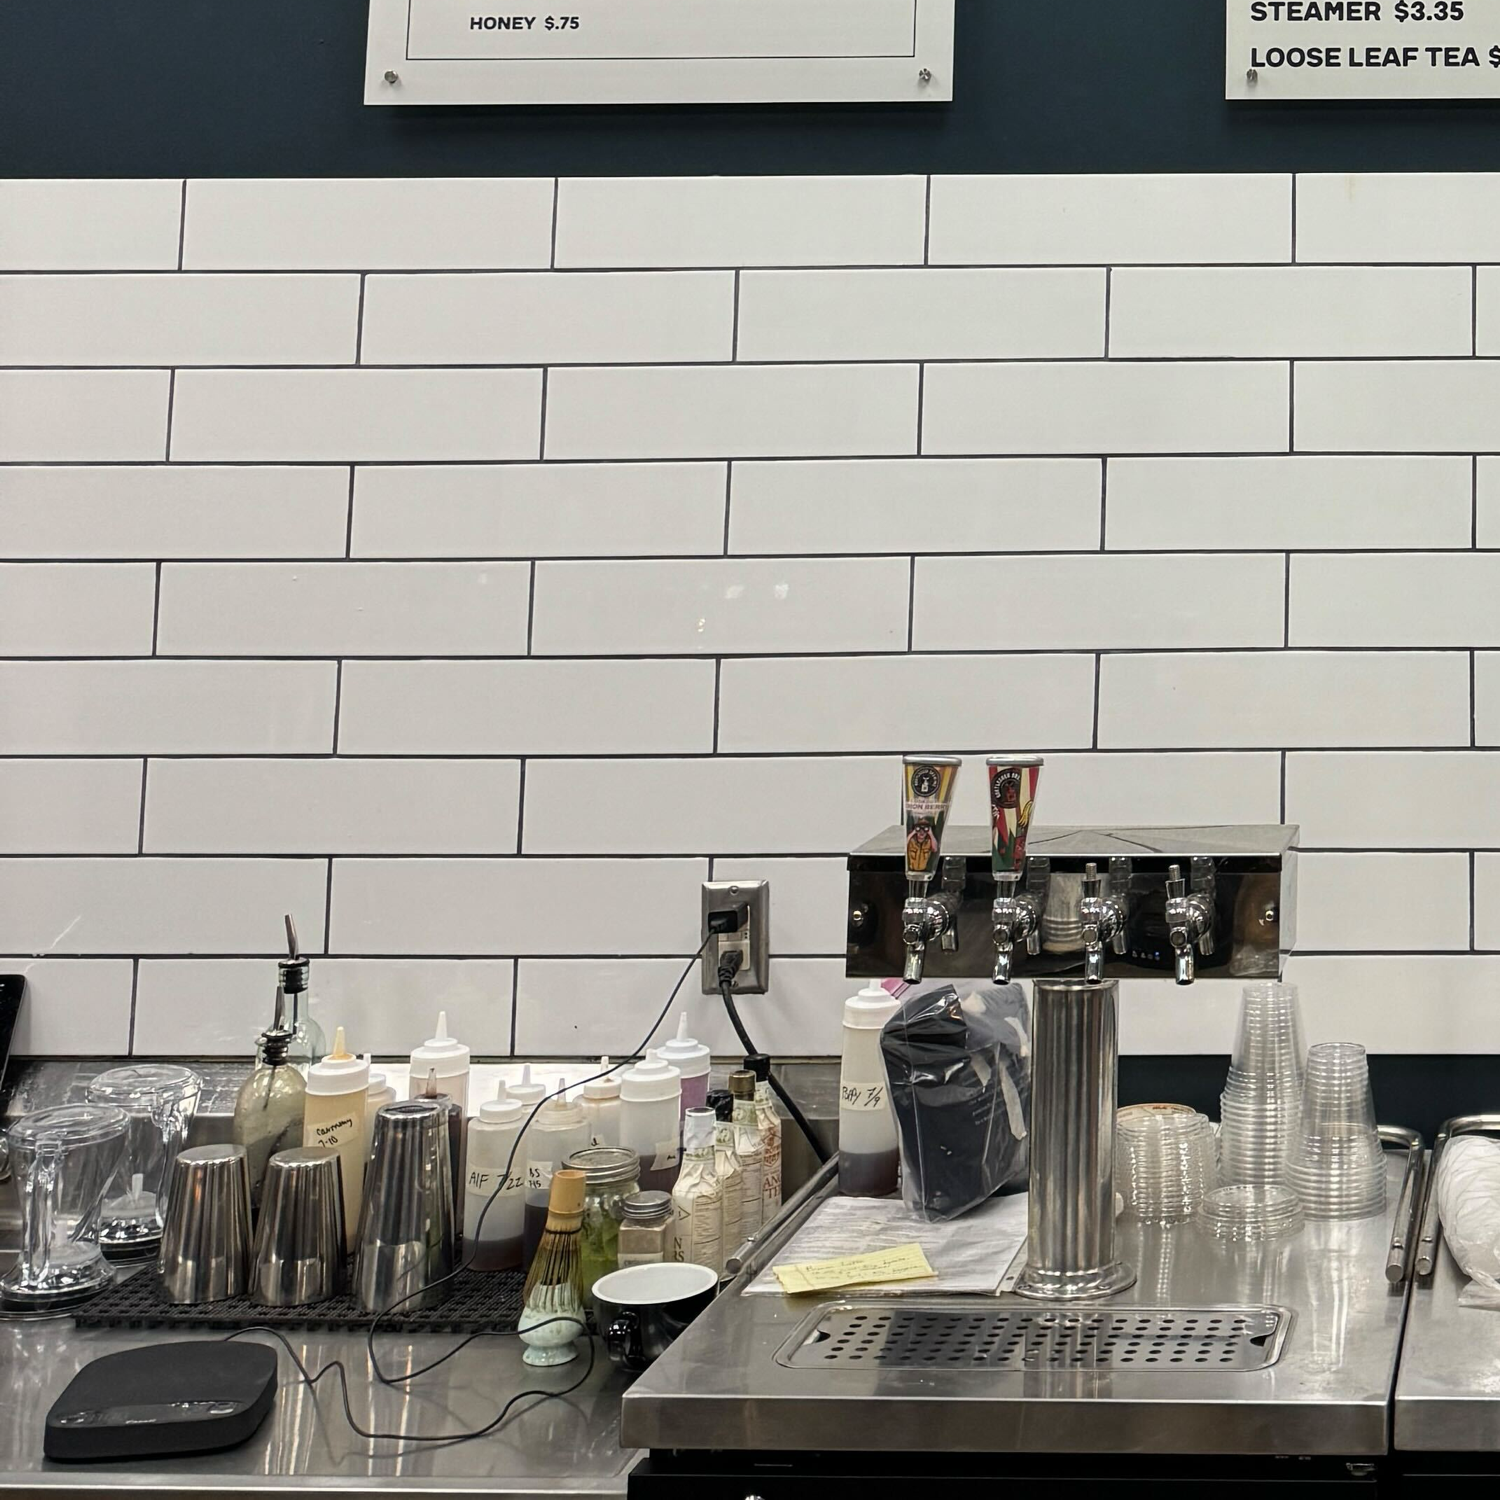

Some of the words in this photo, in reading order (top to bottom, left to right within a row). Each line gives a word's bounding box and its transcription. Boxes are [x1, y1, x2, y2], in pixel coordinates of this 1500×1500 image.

[1250, 1, 1381, 22] STEAMER
[1394, 0, 1464, 23] $3.35
[470, 16, 537, 30] HONEY
[544, 15, 580, 31] $.75
[1251, 47, 1342, 68] LOOSE
[1348, 47, 1419, 68] LEAF
[1424, 46, 1481, 67] TEA
